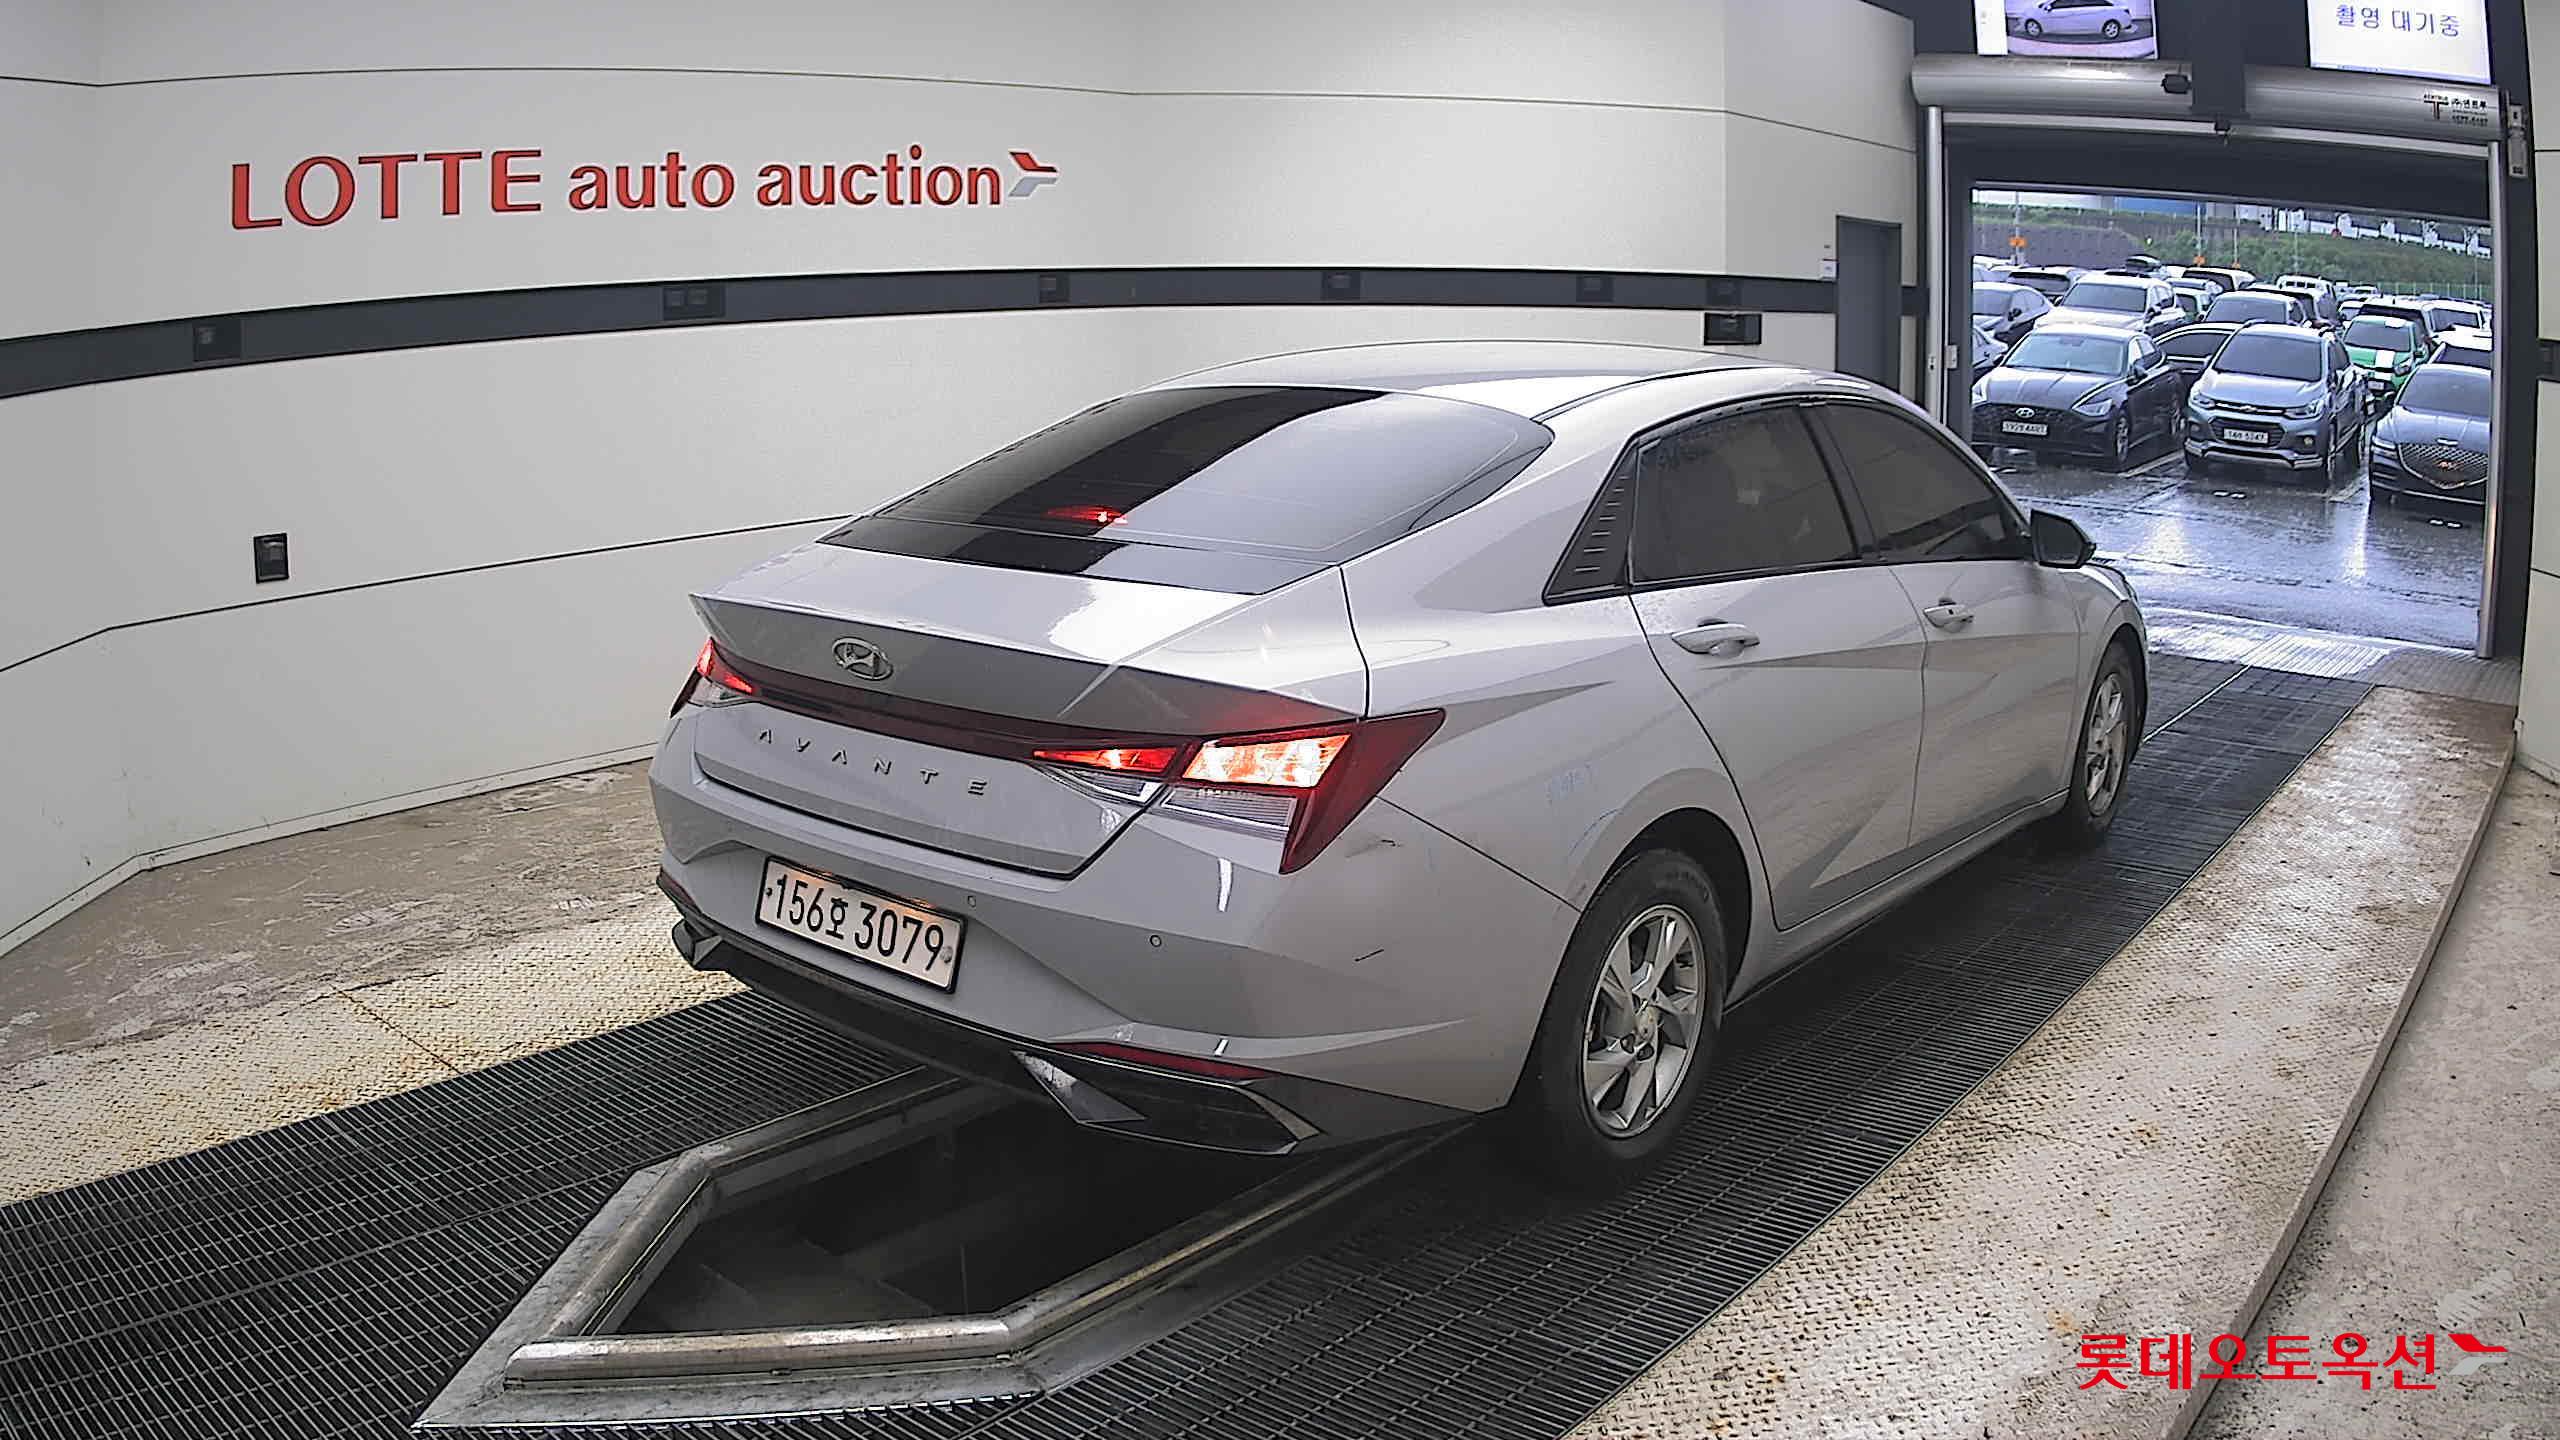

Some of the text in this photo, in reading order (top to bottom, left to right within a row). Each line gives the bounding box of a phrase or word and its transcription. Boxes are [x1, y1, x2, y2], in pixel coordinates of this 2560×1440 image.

[2391, 10, 2460, 37] 대기중
[231, 144, 1002, 231] LOTTE auto auction
[759, 728, 988, 797] AVANTE
[776, 873, 944, 971] 156호 3079
